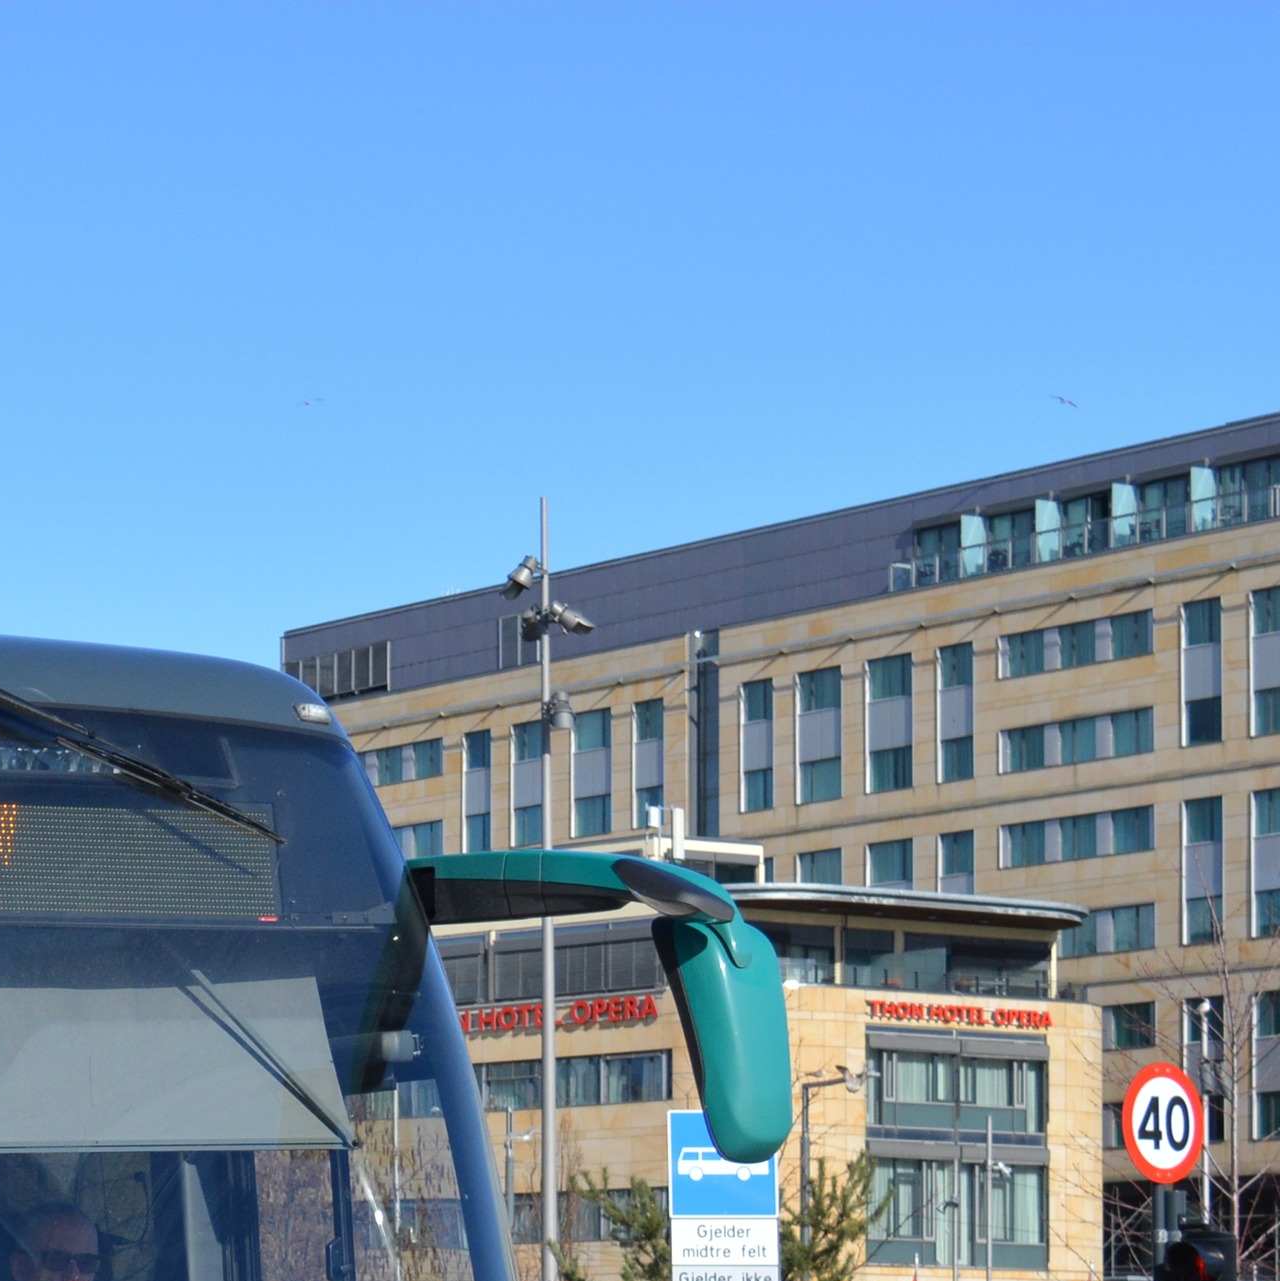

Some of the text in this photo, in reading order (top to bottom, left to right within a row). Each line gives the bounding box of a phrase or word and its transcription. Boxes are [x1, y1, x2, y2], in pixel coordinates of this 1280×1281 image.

[478, 1004, 563, 1032] HOTE
[570, 994, 659, 1025] OPERA
[869, 1000, 1052, 1028] THON HOTEL OPERA
[1137, 1095, 1190, 1152] 40
[697, 1225, 751, 1241] Gjelder
[682, 1245, 767, 1258] midtre felt
